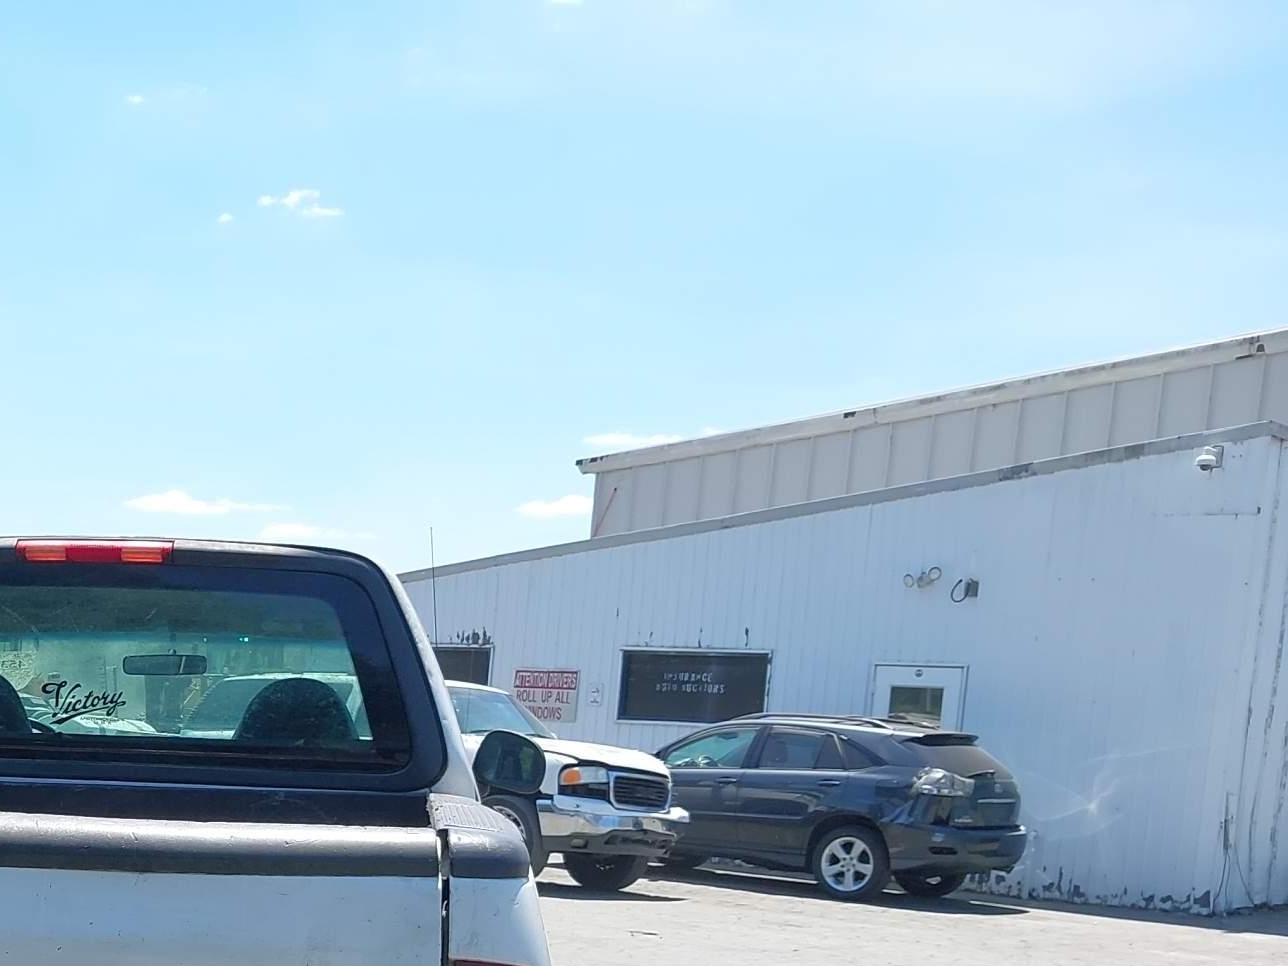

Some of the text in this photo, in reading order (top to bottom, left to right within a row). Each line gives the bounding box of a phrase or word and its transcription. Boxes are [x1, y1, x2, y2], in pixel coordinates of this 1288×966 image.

[515, 672, 576, 688] ATTENTION DRIVERS
[41, 681, 127, 717] Victory
[516, 690, 571, 704] ROLL UP ALL
